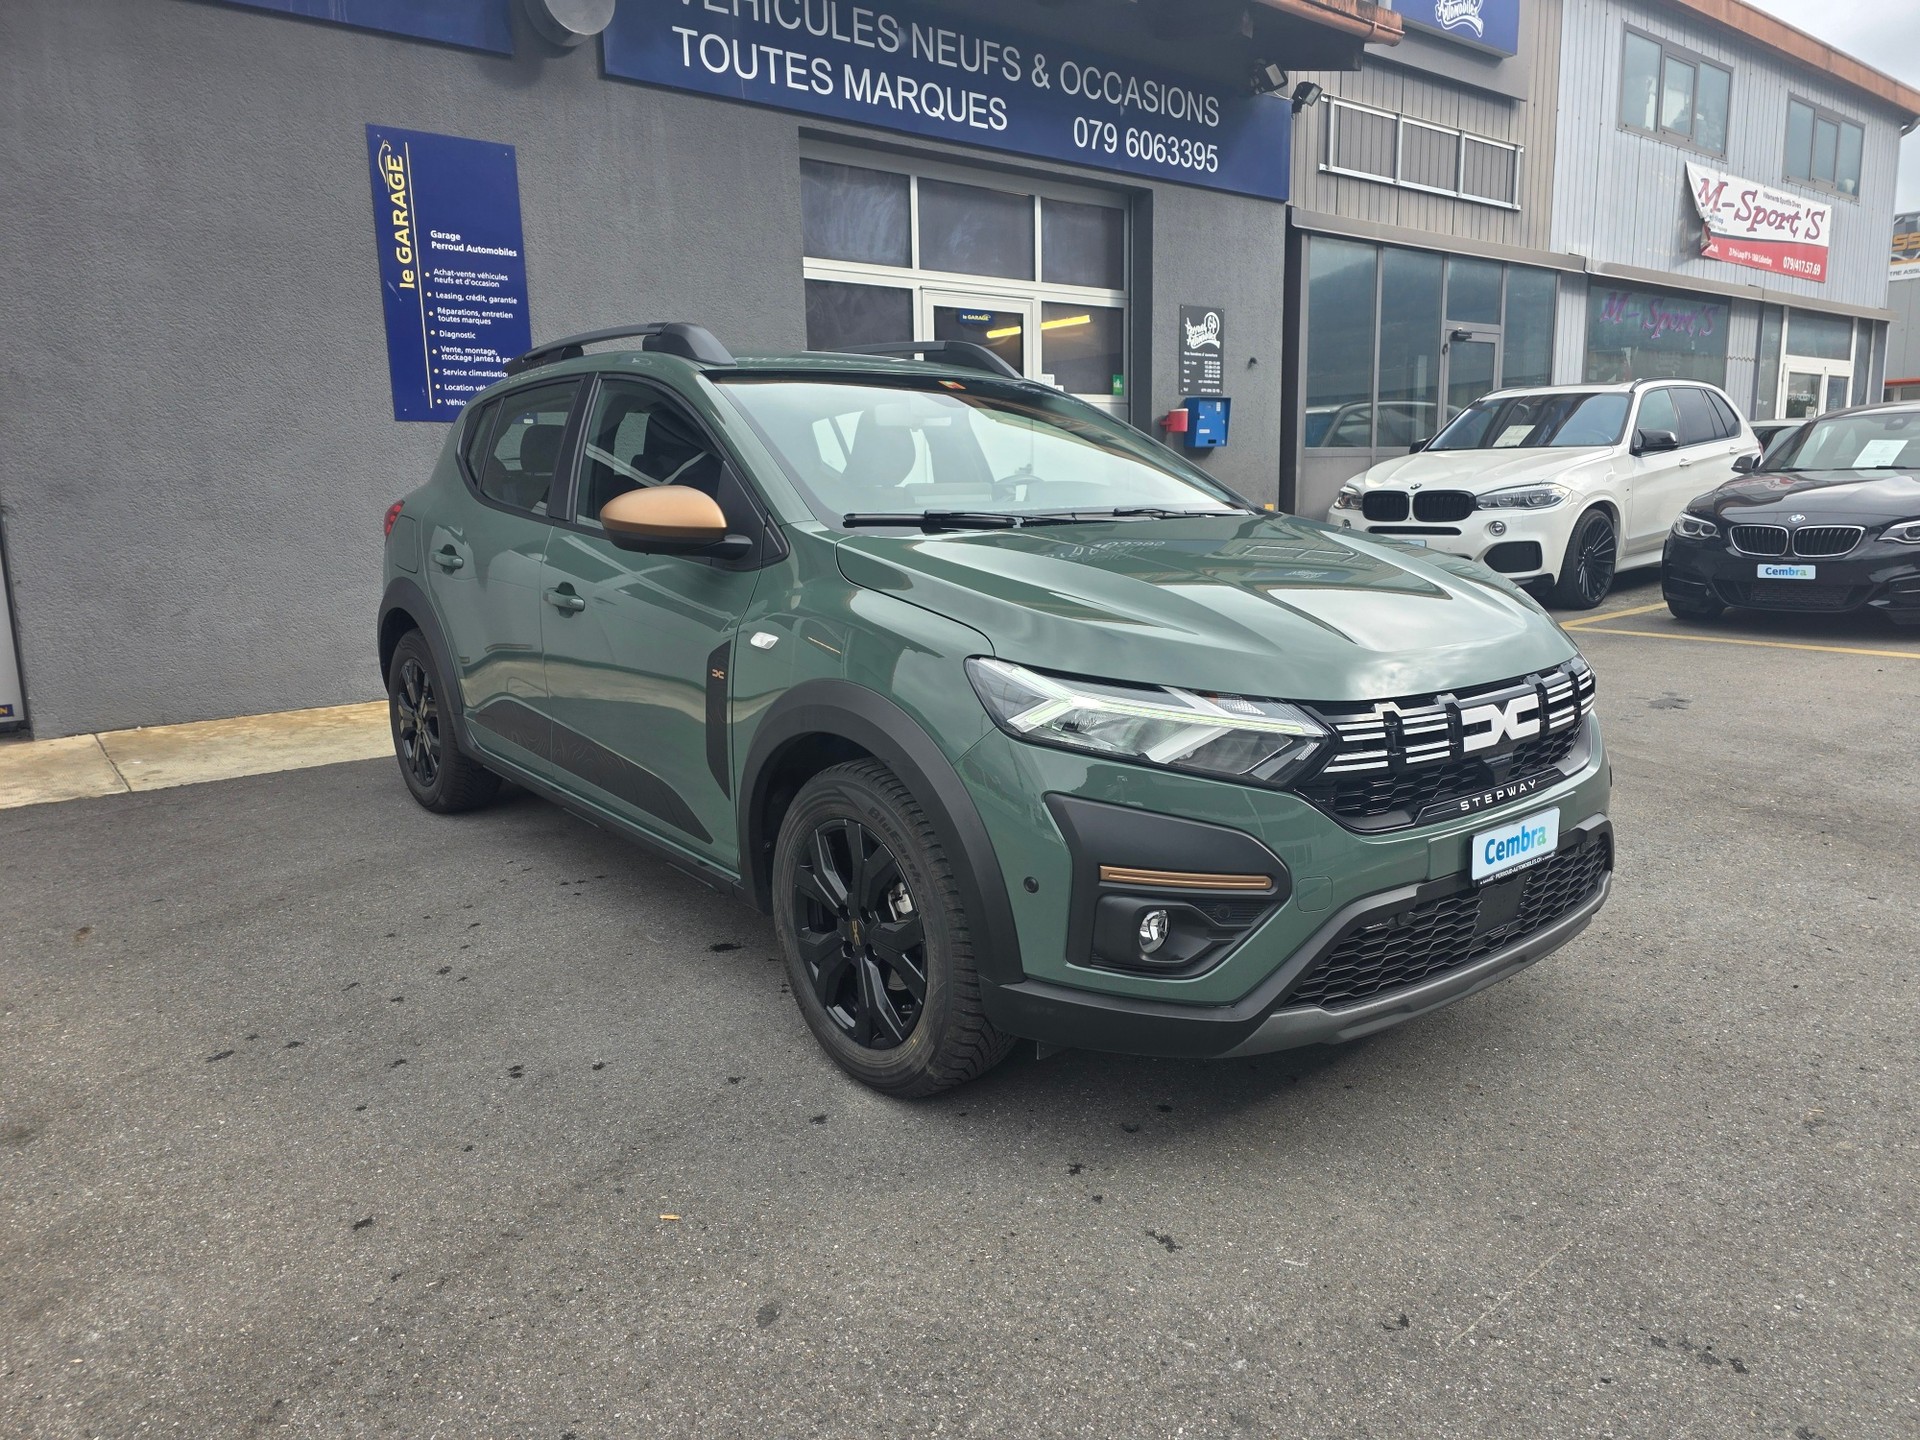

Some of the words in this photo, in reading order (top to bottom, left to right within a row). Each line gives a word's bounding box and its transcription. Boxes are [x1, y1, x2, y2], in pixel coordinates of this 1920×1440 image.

[671, 25, 834, 95] TOUTES
[844, 63, 1008, 131] MARQUES
[911, 22, 1021, 82] NEUFS
[1030, 53, 1050, 90] &
[1059, 60, 1220, 128] OCCASIONS
[1073, 116, 1118, 153] 079
[1125, 127, 1219, 173] 6063395
[387, 154, 413, 264] GARAGE
[430, 230, 461, 242] Garage
[431, 241, 464, 252] Perroud
[466, 245, 518, 257] Automobiles
[399, 269, 415, 289] le
[433, 268, 476, 278] Achat-vente
[477, 271, 508, 281] véhicules
[464, 278, 500, 288] d'occasion
[435, 292, 464, 302] Leasing,
[465, 294, 488, 302] crédit,
[489, 296, 518, 304] garantie
[437, 307, 480, 317] Réparations,
[482, 310, 513, 319] entretien
[437, 315, 460, 323] toutes
[439, 330, 476, 339] Diagnostic
[440, 345, 463, 354] Vente,
[465, 348, 498, 356] montage,
[441, 354, 472, 363] stockage
[473, 355, 494, 363] jantes
[442, 368, 467, 376] Service
[444, 384, 474, 392] Location
[1765, 566, 1807, 576] Cembra
[1460, 779, 1537, 811] STEPWAY
[1484, 824, 1547, 866] Cembra
